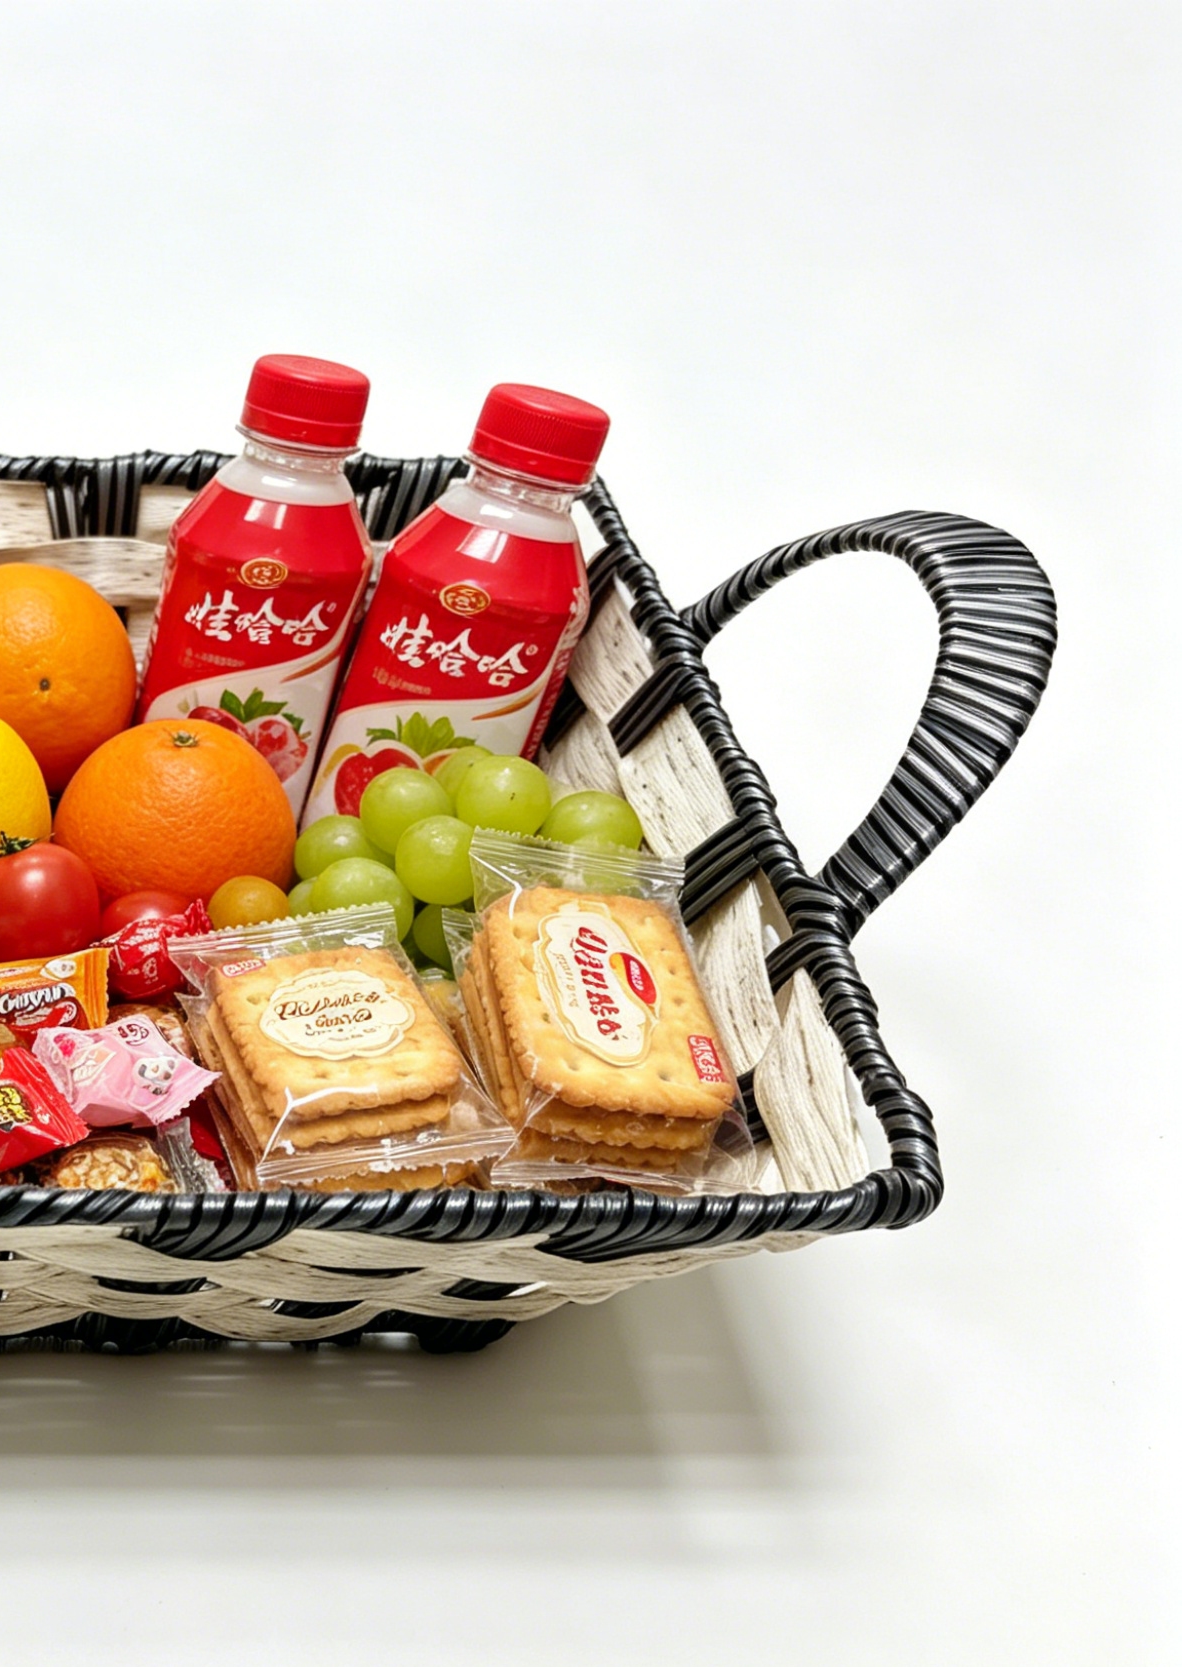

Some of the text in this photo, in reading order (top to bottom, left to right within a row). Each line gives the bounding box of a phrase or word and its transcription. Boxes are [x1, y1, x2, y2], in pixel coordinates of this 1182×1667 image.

[184, 589, 330, 646] 娃哈哈
[379, 613, 529, 688] 娃哈哈
